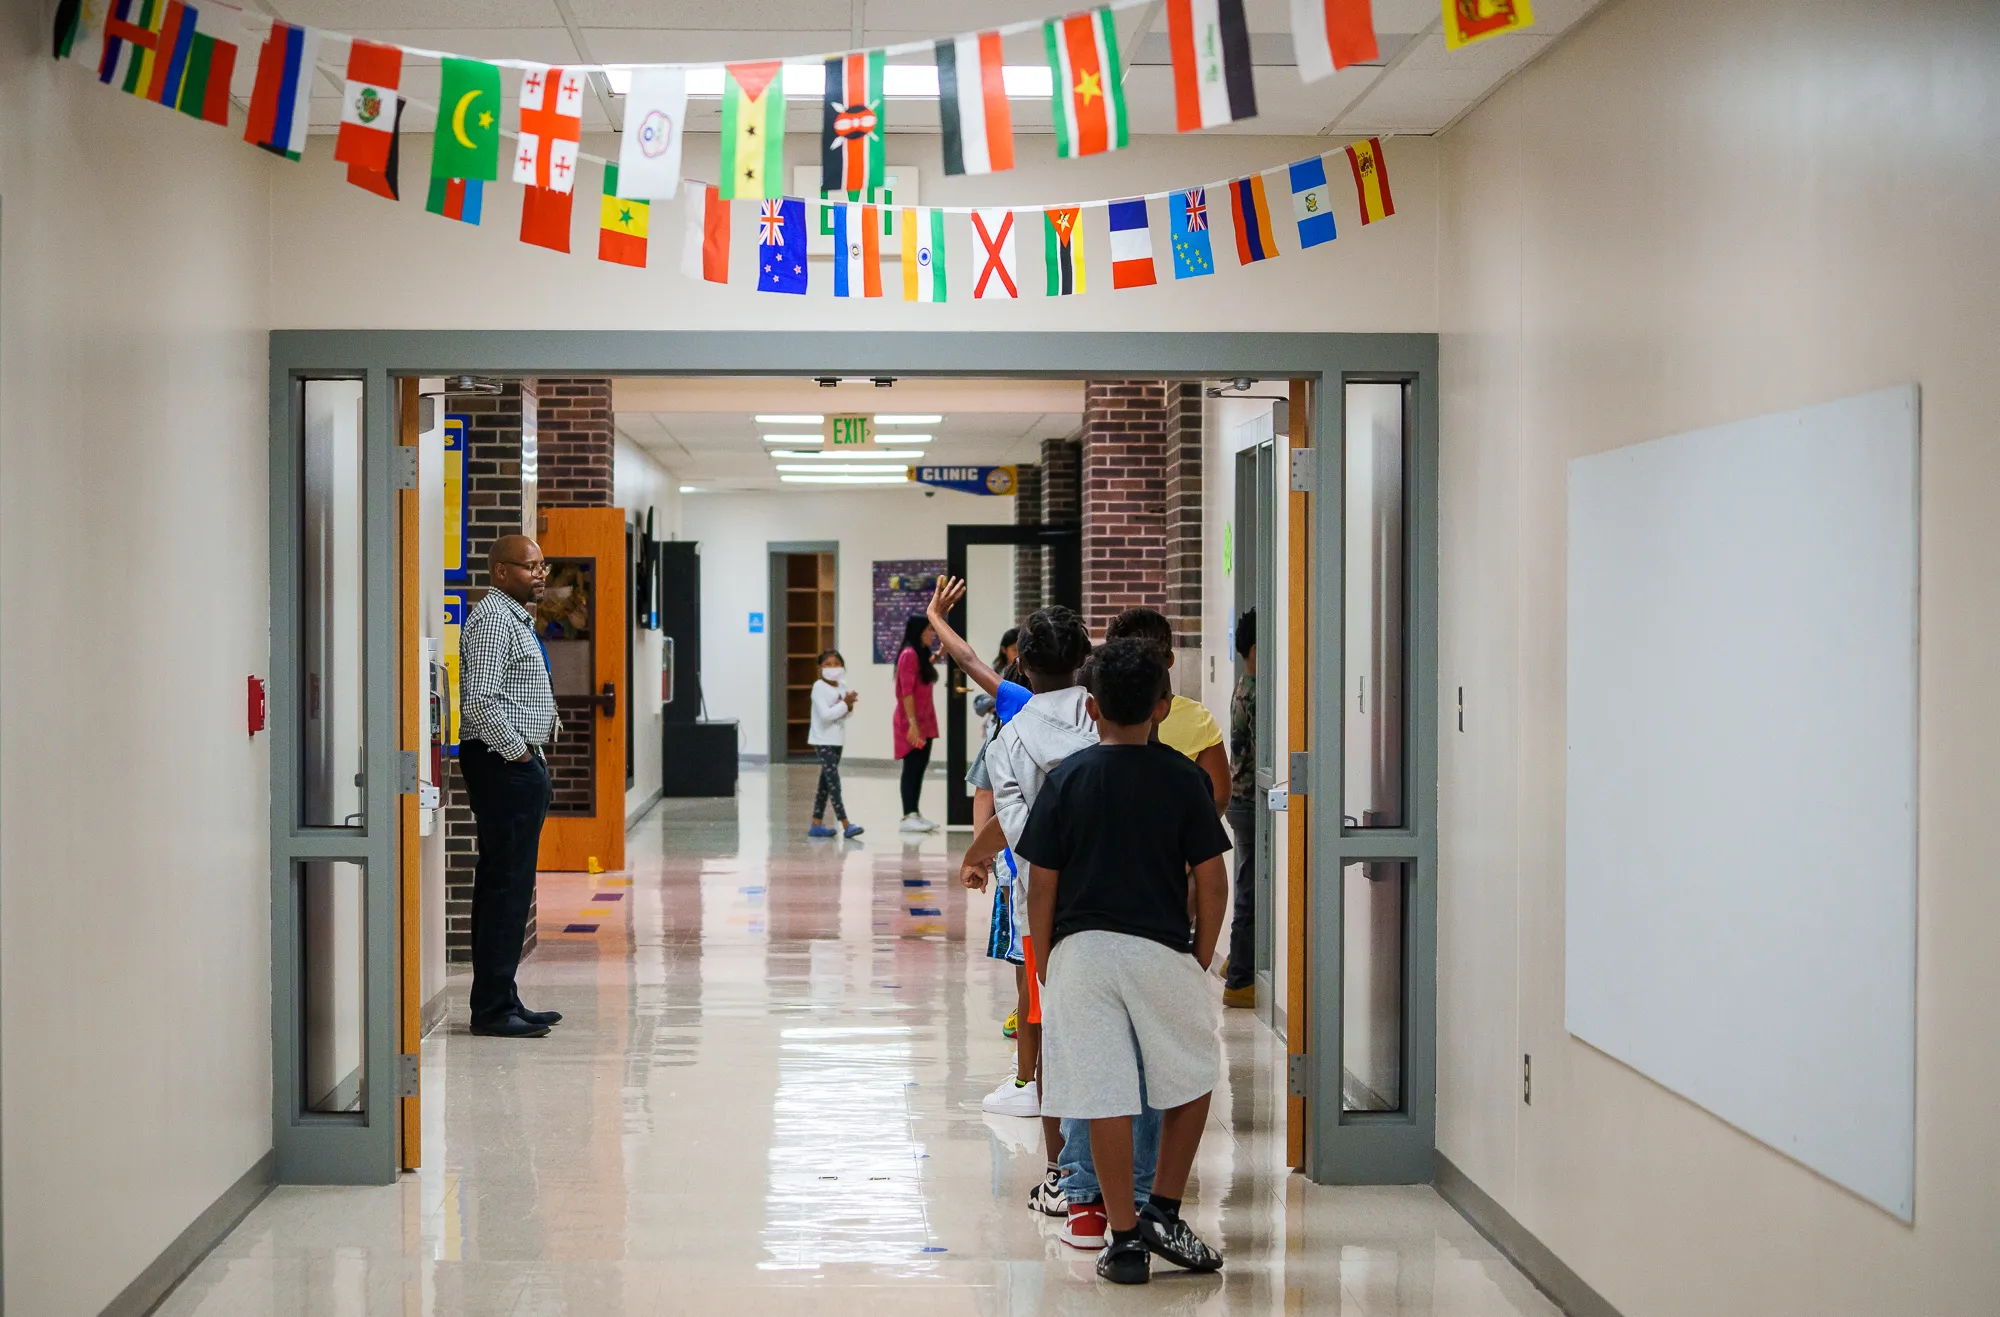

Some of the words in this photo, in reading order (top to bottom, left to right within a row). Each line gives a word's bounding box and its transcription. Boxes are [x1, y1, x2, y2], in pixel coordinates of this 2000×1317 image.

[820, 176, 897, 235] ET
[833, 417, 867, 444] EXIT
[922, 467, 979, 481] CLINIC
